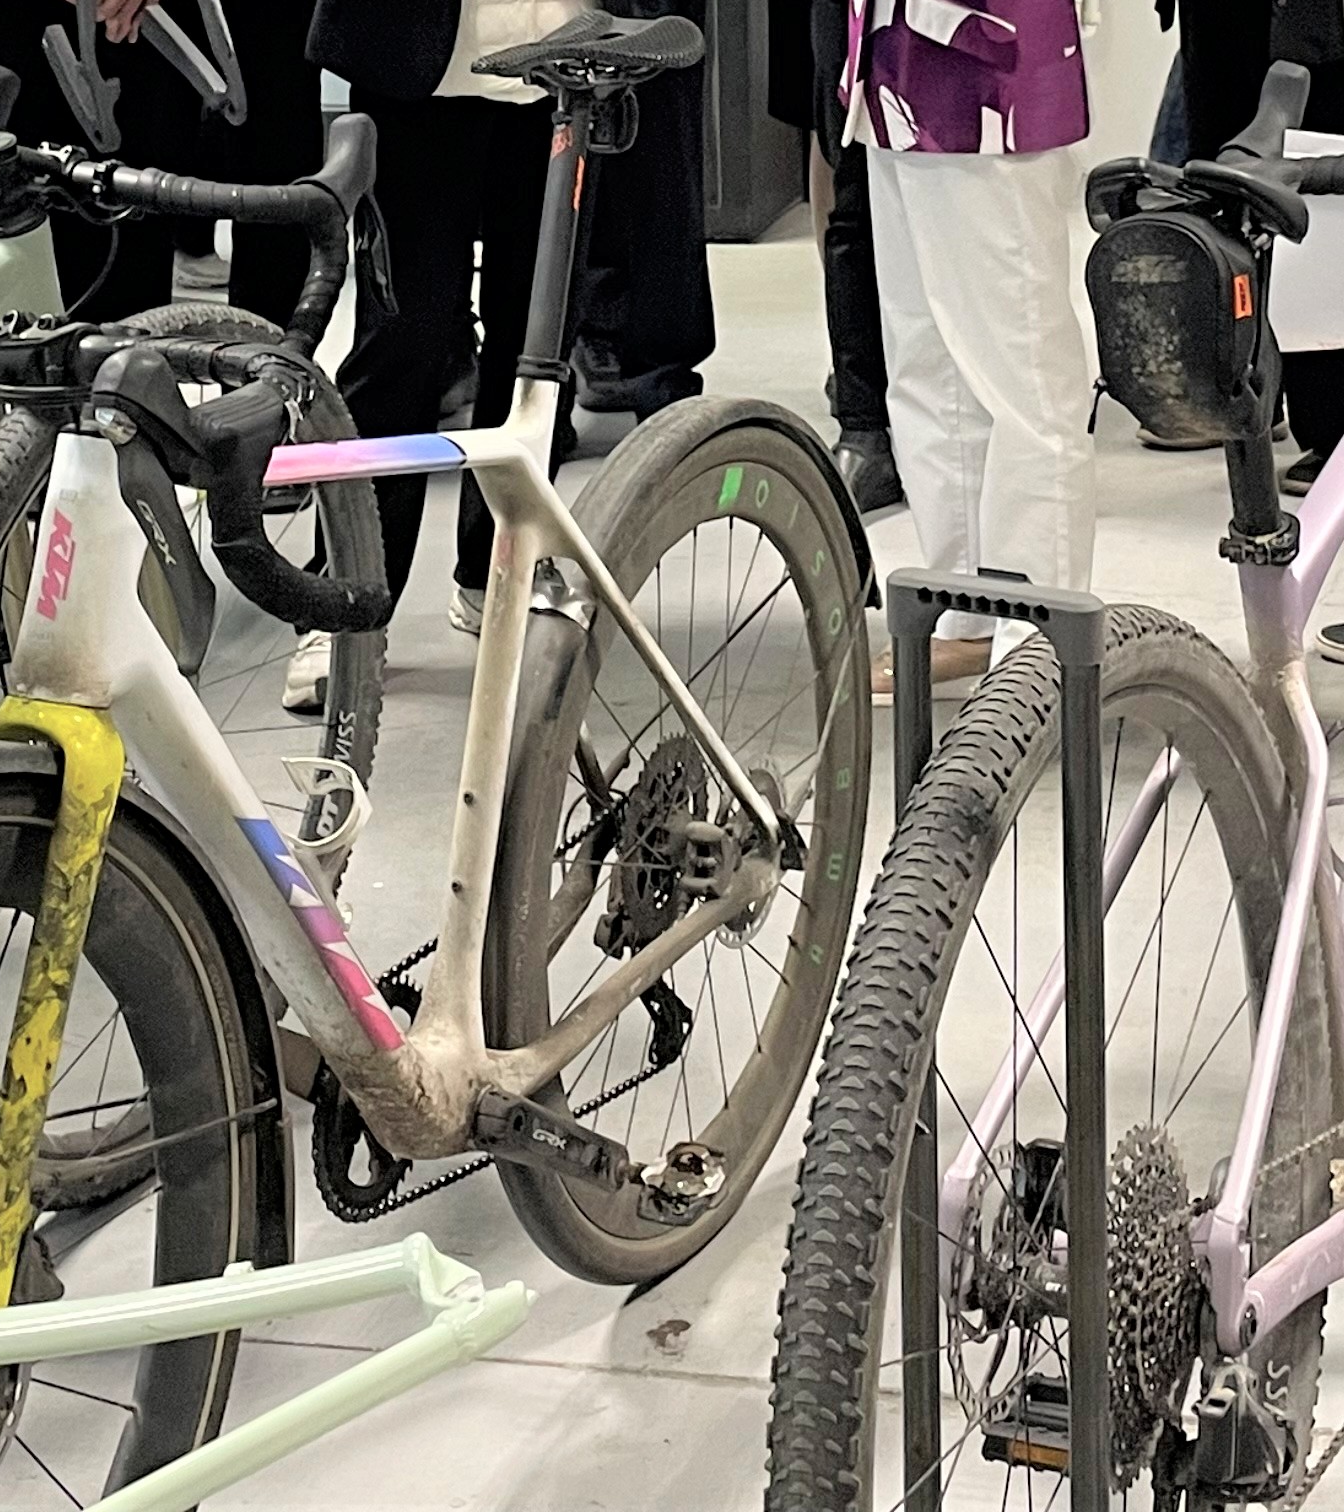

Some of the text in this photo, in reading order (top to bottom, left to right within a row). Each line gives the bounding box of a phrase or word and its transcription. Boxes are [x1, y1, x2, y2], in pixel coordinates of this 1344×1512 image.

[137, 497, 176, 566] GRX
[36, 508, 76, 621] KTM
[316, 790, 340, 838] DT
[532, 1129, 567, 1150] GRX
